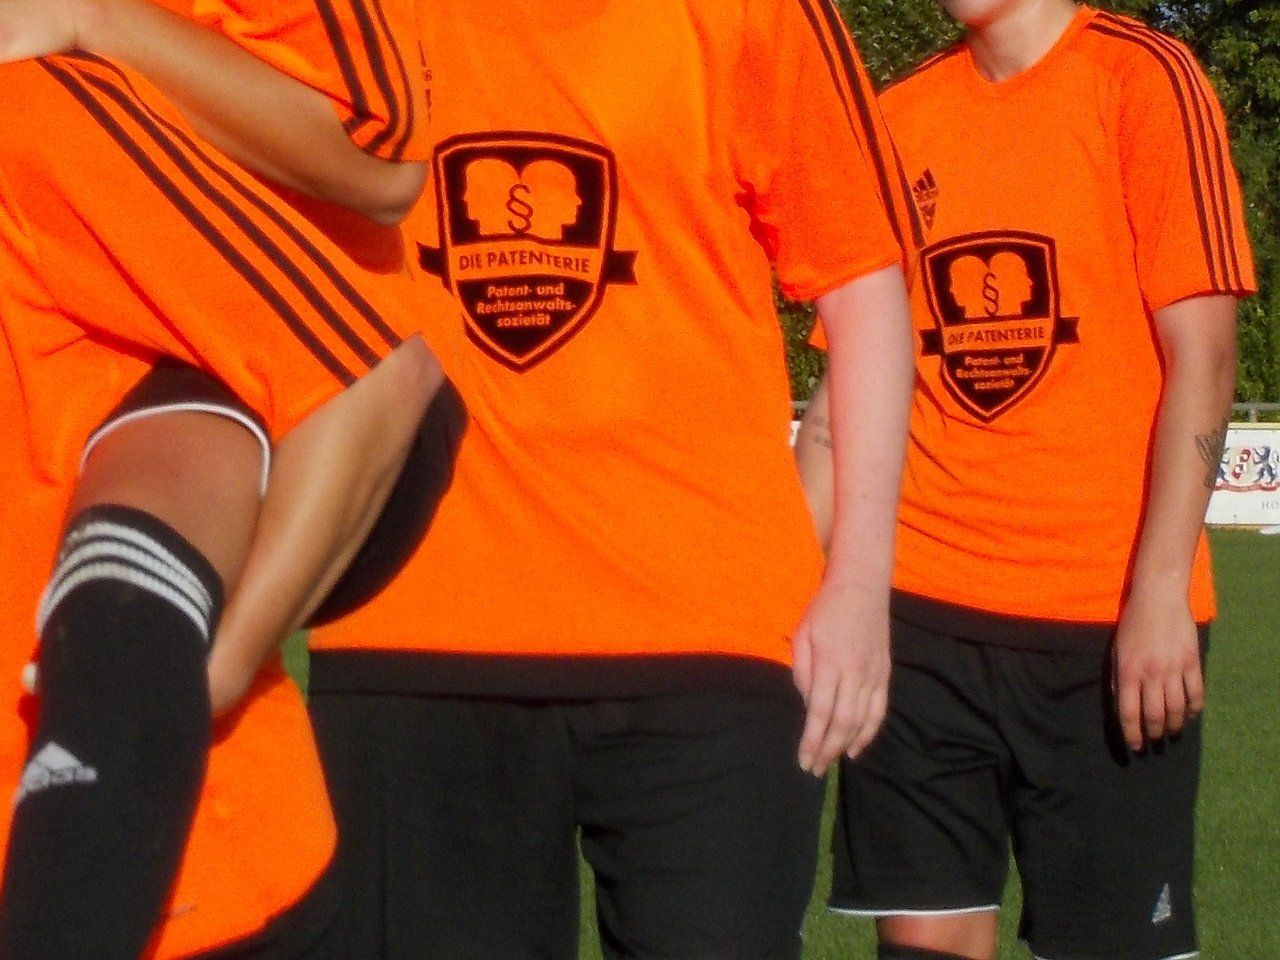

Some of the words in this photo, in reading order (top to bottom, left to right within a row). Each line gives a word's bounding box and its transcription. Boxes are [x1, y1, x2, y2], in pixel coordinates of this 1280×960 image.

[459, 252, 482, 271] DIE
[487, 249, 591, 273] PATENTERIE
[536, 282, 565, 296] und
